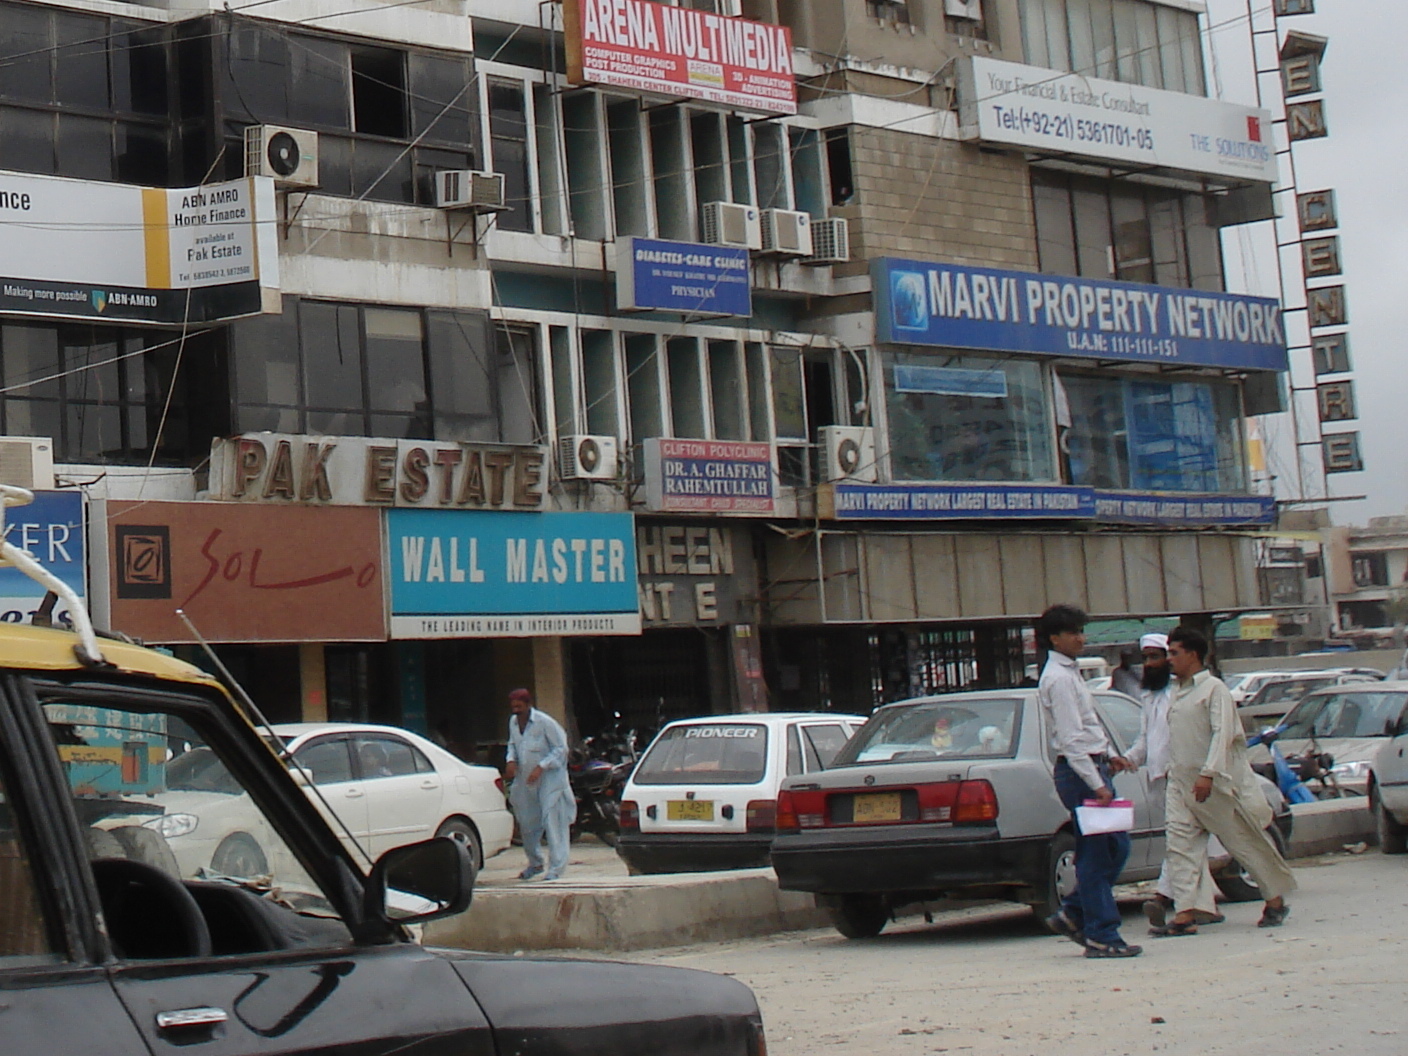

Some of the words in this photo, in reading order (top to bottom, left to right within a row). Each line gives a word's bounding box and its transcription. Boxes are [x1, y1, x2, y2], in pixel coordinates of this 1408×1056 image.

[662, 6, 792, 75] MULTIMEDIA
[585, 46, 633, 64] COMPUTER
[634, 55, 676, 71] GRAPHICS
[586, 58, 609, 70] POST
[610, 61, 665, 79] PRODUCTION
[749, 74, 792, 90] ANIMATION
[987, 72, 1013, 92] Your
[1015, 76, 1058, 102] Financial
[1060, 83, 1069, 102] &
[1070, 86, 1101, 109] Estate
[1102, 91, 1150, 117] Consultant
[1077, 117, 1154, 150] 5361701-05
[1189, 133, 1211, 153] THE
[181, 193, 208, 210] ABN
[209, 188, 239, 206] AMRO
[174, 212, 208, 227] Home
[209, 206, 246, 222] Finance
[194, 232, 226, 246] available
[226, 231, 235, 242] at
[187, 247, 209, 262] Pak
[211, 245, 242, 260] Estate
[636, 249, 712, 268] DIABETES-CARE
[714, 256, 747, 271] CLINIC
[3, 284, 34, 302] Making
[34, 288, 56, 301] more
[55, 289, 88, 304] possible
[671, 285, 716, 298] PHYSICIAN
[927, 269, 1021, 323] MARVI
[1025, 279, 1161, 333] PROPERTY
[1166, 293, 1284, 345] NETWORK
[1303, 196, 1353, 468] CENTRE
[1111, 334, 1179, 357] 111-111-151
[663, 443, 706, 457] CLIFTON
[709, 444, 767, 458] POLYCLINIC
[234, 439, 338, 501] PAK
[364, 445, 545, 507] ESTATE
[665, 461, 688, 477] DR.
[691, 462, 703, 477] A.
[705, 462, 767, 479] GHAFFAR
[665, 478, 768, 496] RAHEMTULLAH
[867, 492, 910, 511] PROPERTY
[911, 493, 951, 511] NETWORK
[952, 493, 986, 511] LARGEST
[987, 493, 1006, 510] REAL
[402, 536, 485, 583] WALL
[506, 538, 626, 584] MASTER
[421, 620, 438, 632] THE
[443, 620, 483, 632] LEADING
[487, 620, 510, 632] NAME
[514, 619, 524, 632] IN
[528, 619, 569, 631] INTERIOR
[572, 618, 615, 631] PRODUCTS
[685, 727, 758, 739] PIONEER
